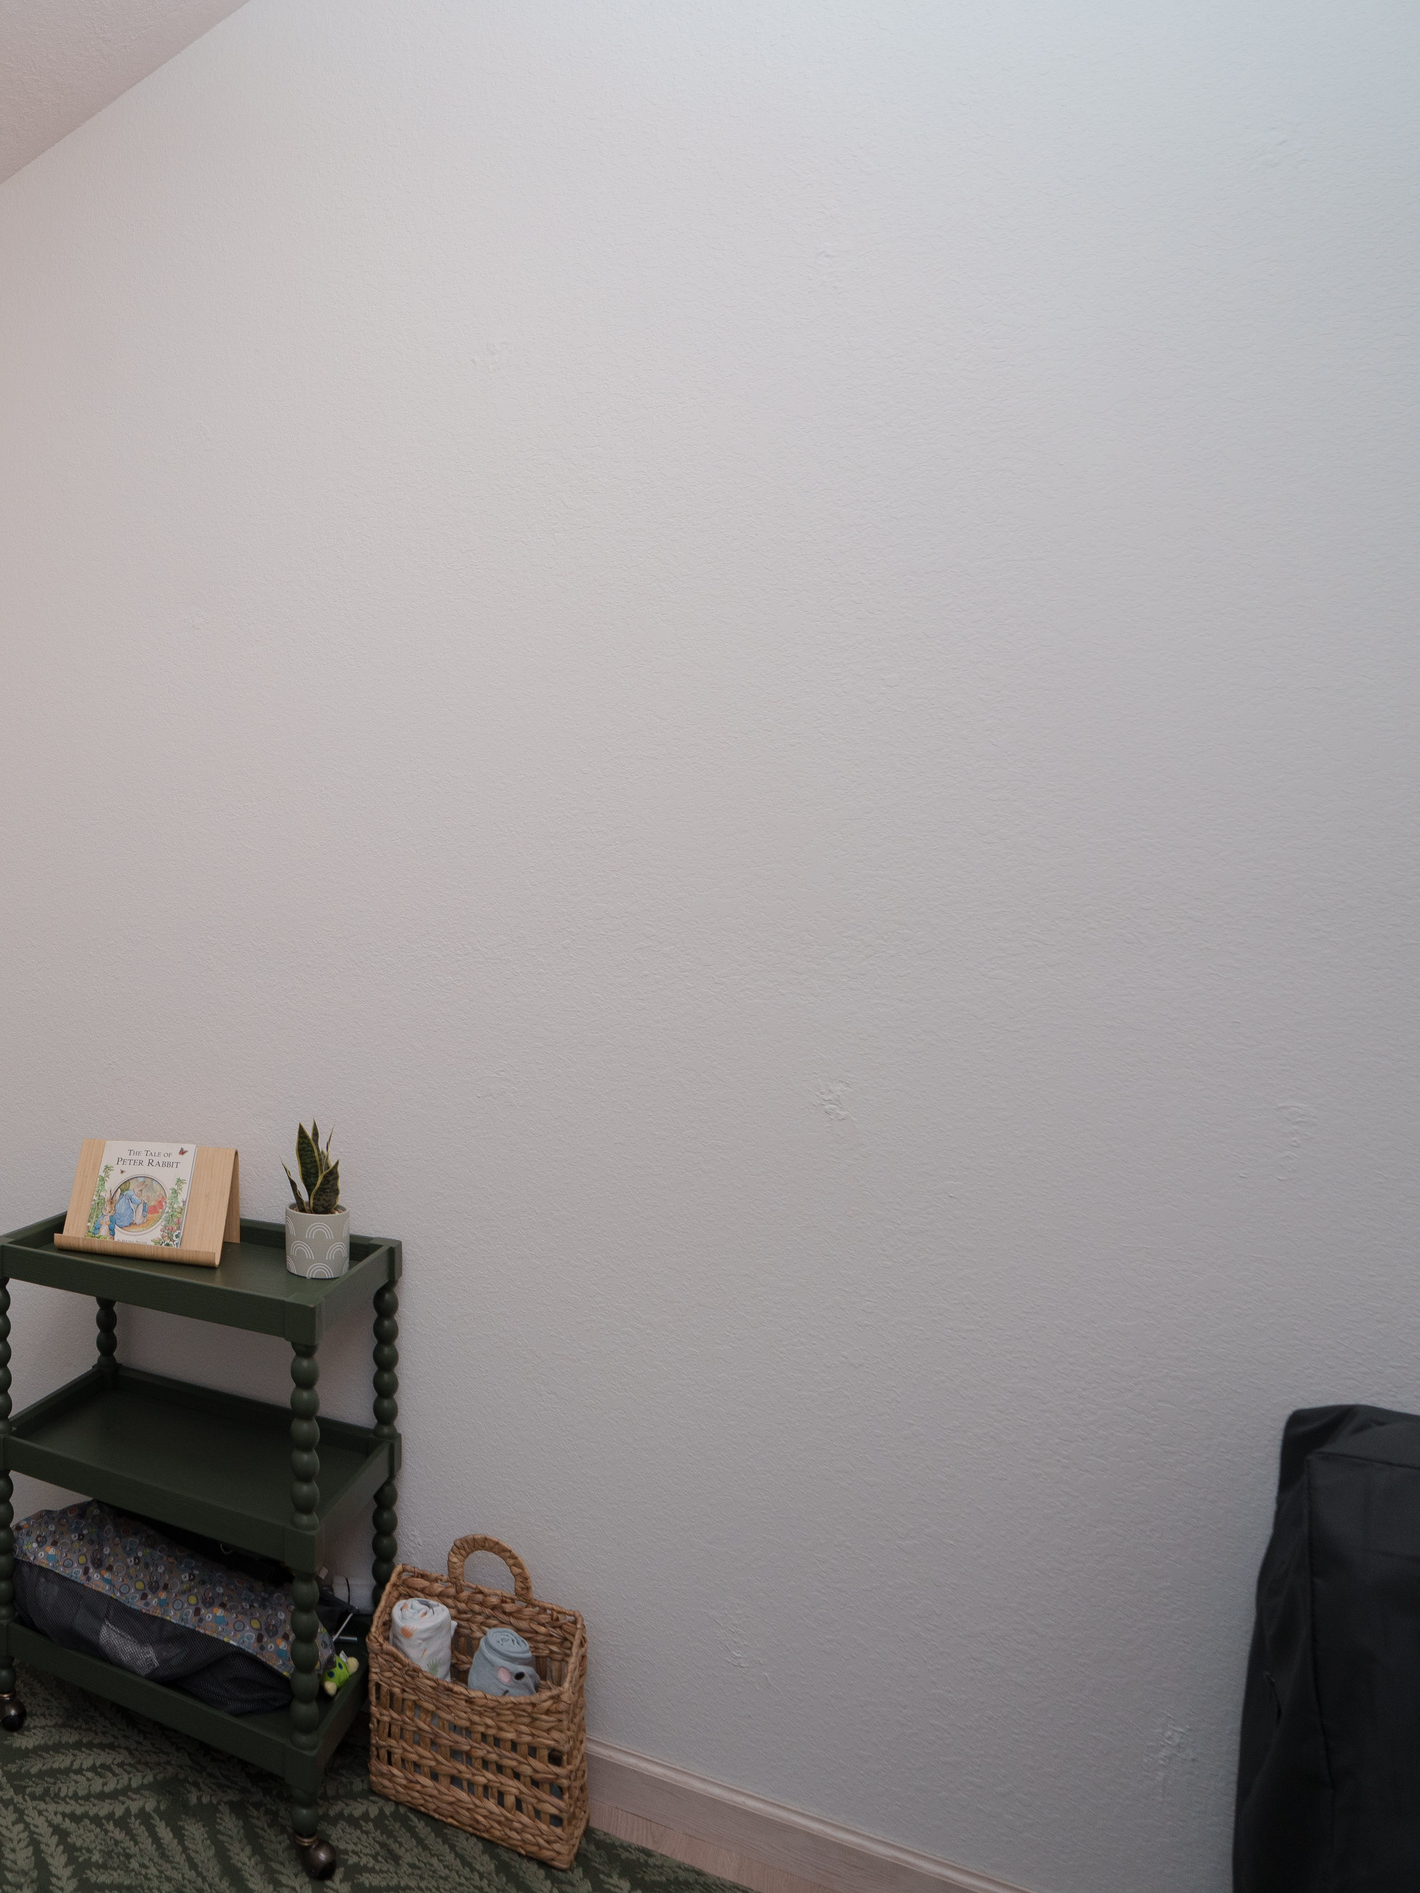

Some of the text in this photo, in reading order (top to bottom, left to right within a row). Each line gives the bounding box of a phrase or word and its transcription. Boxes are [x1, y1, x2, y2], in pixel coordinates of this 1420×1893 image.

[127, 1149, 142, 1157] THE
[144, 1149, 162, 1157] TALE
[116, 1157, 181, 1169] PETER RABBIT
